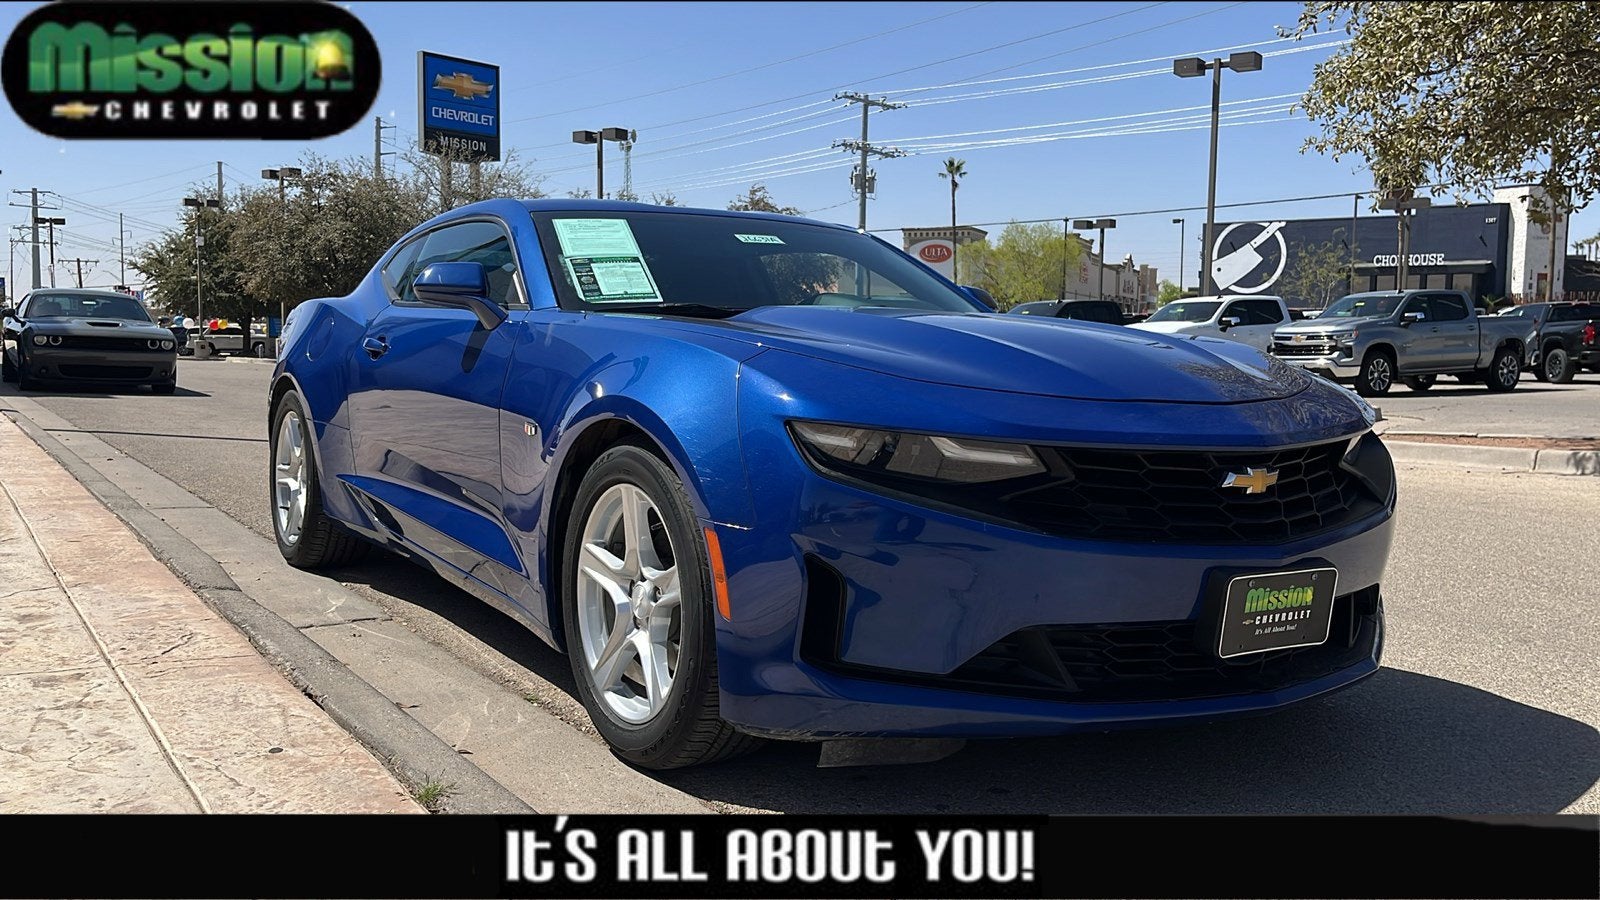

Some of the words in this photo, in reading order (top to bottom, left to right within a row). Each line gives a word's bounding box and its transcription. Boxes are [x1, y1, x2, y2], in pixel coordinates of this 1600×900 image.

[432, 106, 494, 126] CHEVROLET
[440, 135, 487, 151] MISSION
[925, 247, 948, 257] ULTA
[1255, 609, 1311, 625] CHEVROLET
